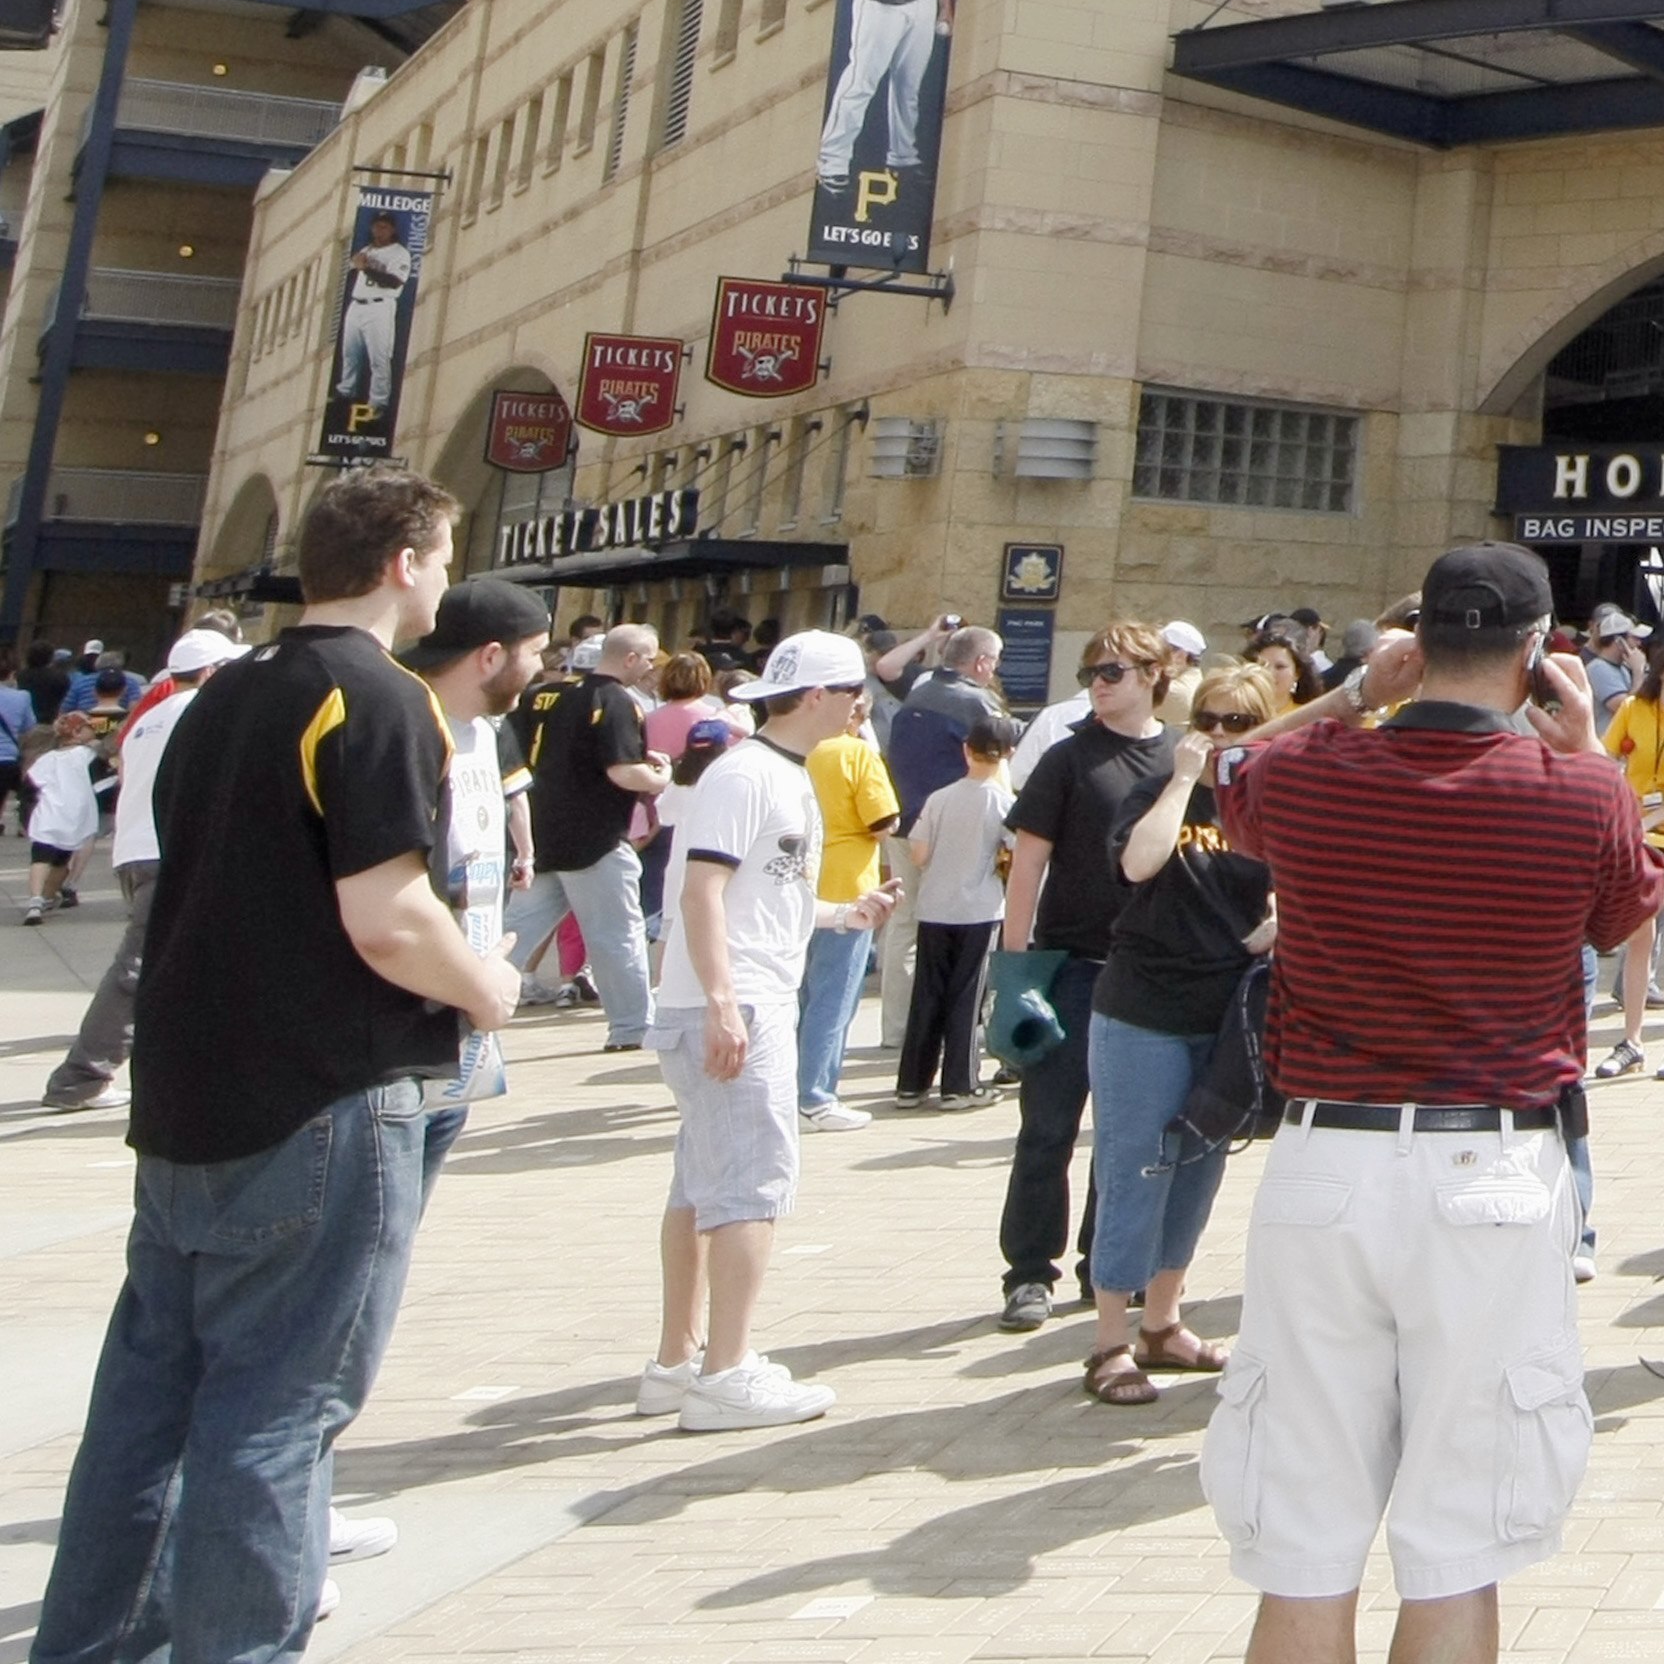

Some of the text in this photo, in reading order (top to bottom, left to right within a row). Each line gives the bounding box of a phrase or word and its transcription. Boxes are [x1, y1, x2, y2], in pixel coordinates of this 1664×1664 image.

[360, 192, 431, 214] MILLEDGE
[854, 171, 898, 223] P
[823, 225, 860, 244] LET'S
[861, 229, 882, 246] GO
[727, 291, 818, 324] TICKETS
[731, 330, 802, 361] PIRATES
[593, 345, 675, 374] TICKETS
[600, 378, 660, 404] PIRATES
[501, 399, 566, 423] TICKETS
[505, 425, 556, 447] PIRATES
[500, 489, 684, 563] TICKET SALES
[1523, 518, 1575, 539] BAG
